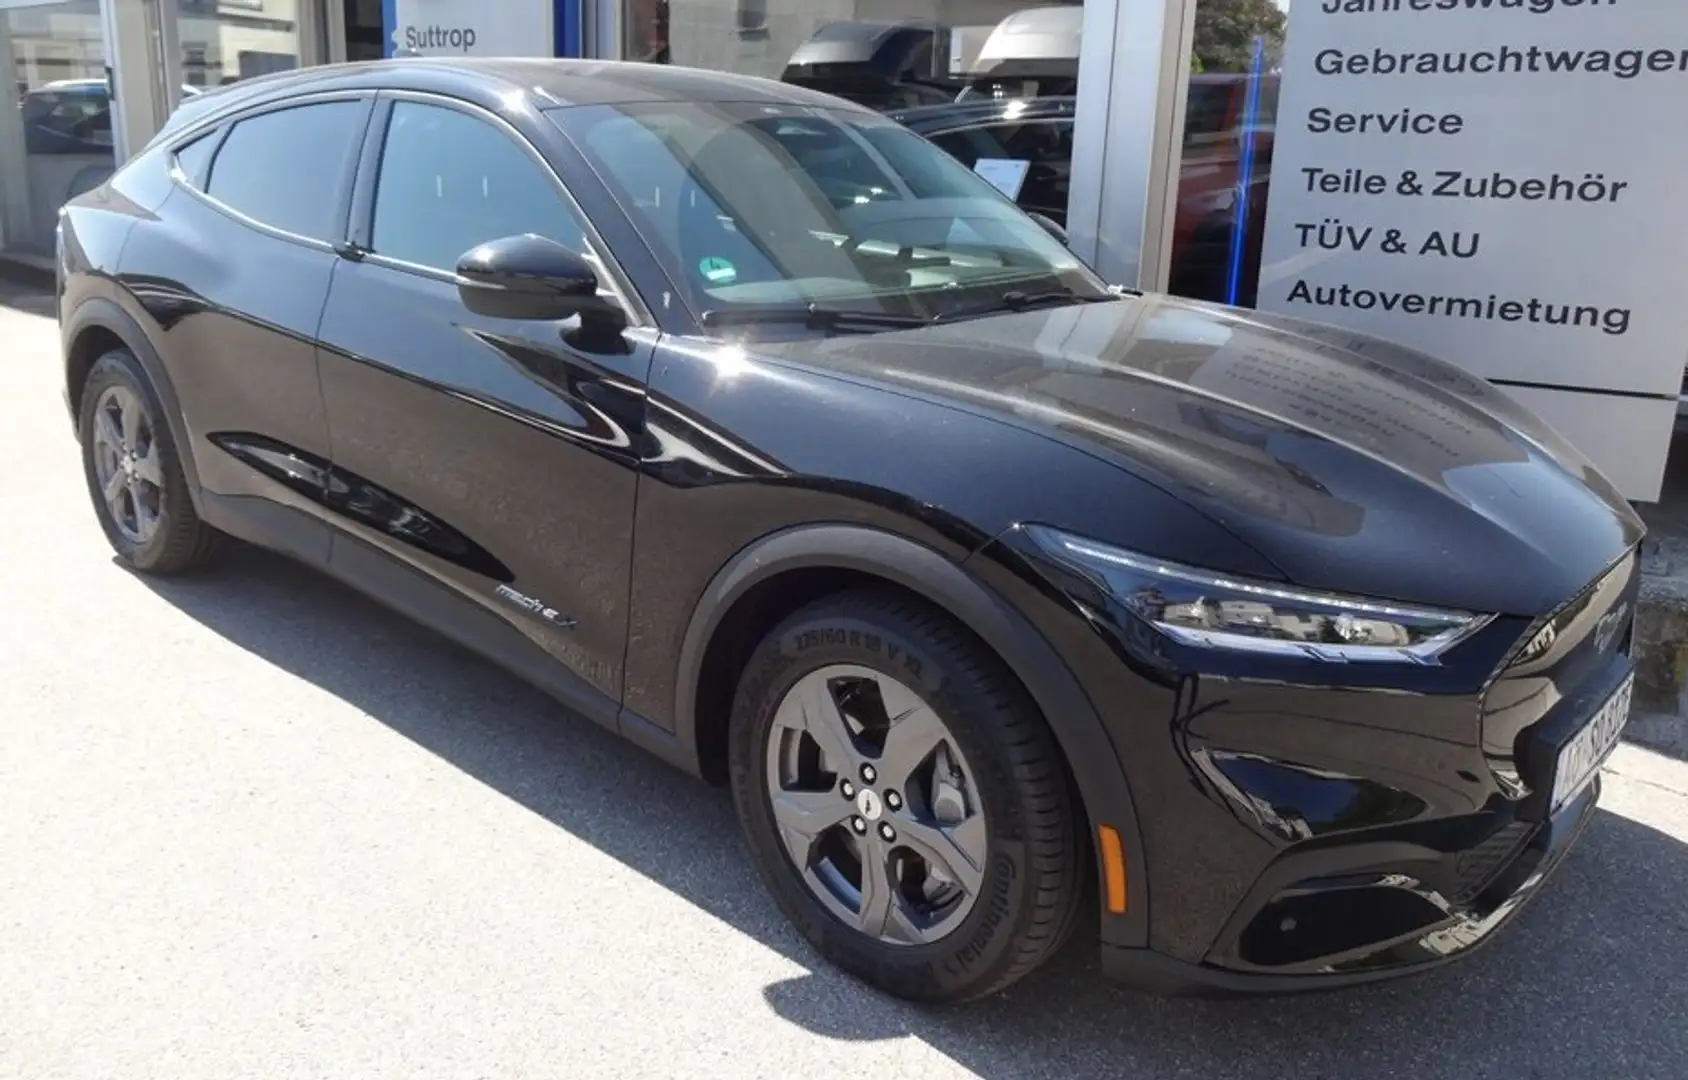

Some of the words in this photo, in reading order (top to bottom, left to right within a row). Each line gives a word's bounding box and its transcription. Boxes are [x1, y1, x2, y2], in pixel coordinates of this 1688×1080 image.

[405, 25, 476, 52] Suttrop
[1307, 107, 1464, 135] Service
[1301, 168, 1387, 195] Teile
[1396, 170, 1423, 196] &
[1431, 171, 1628, 202] Zubehör
[1295, 218, 1373, 251] TÜV
[1380, 229, 1407, 254] &
[1418, 231, 1480, 258] AU
[1286, 279, 1631, 335] Autovermietung
